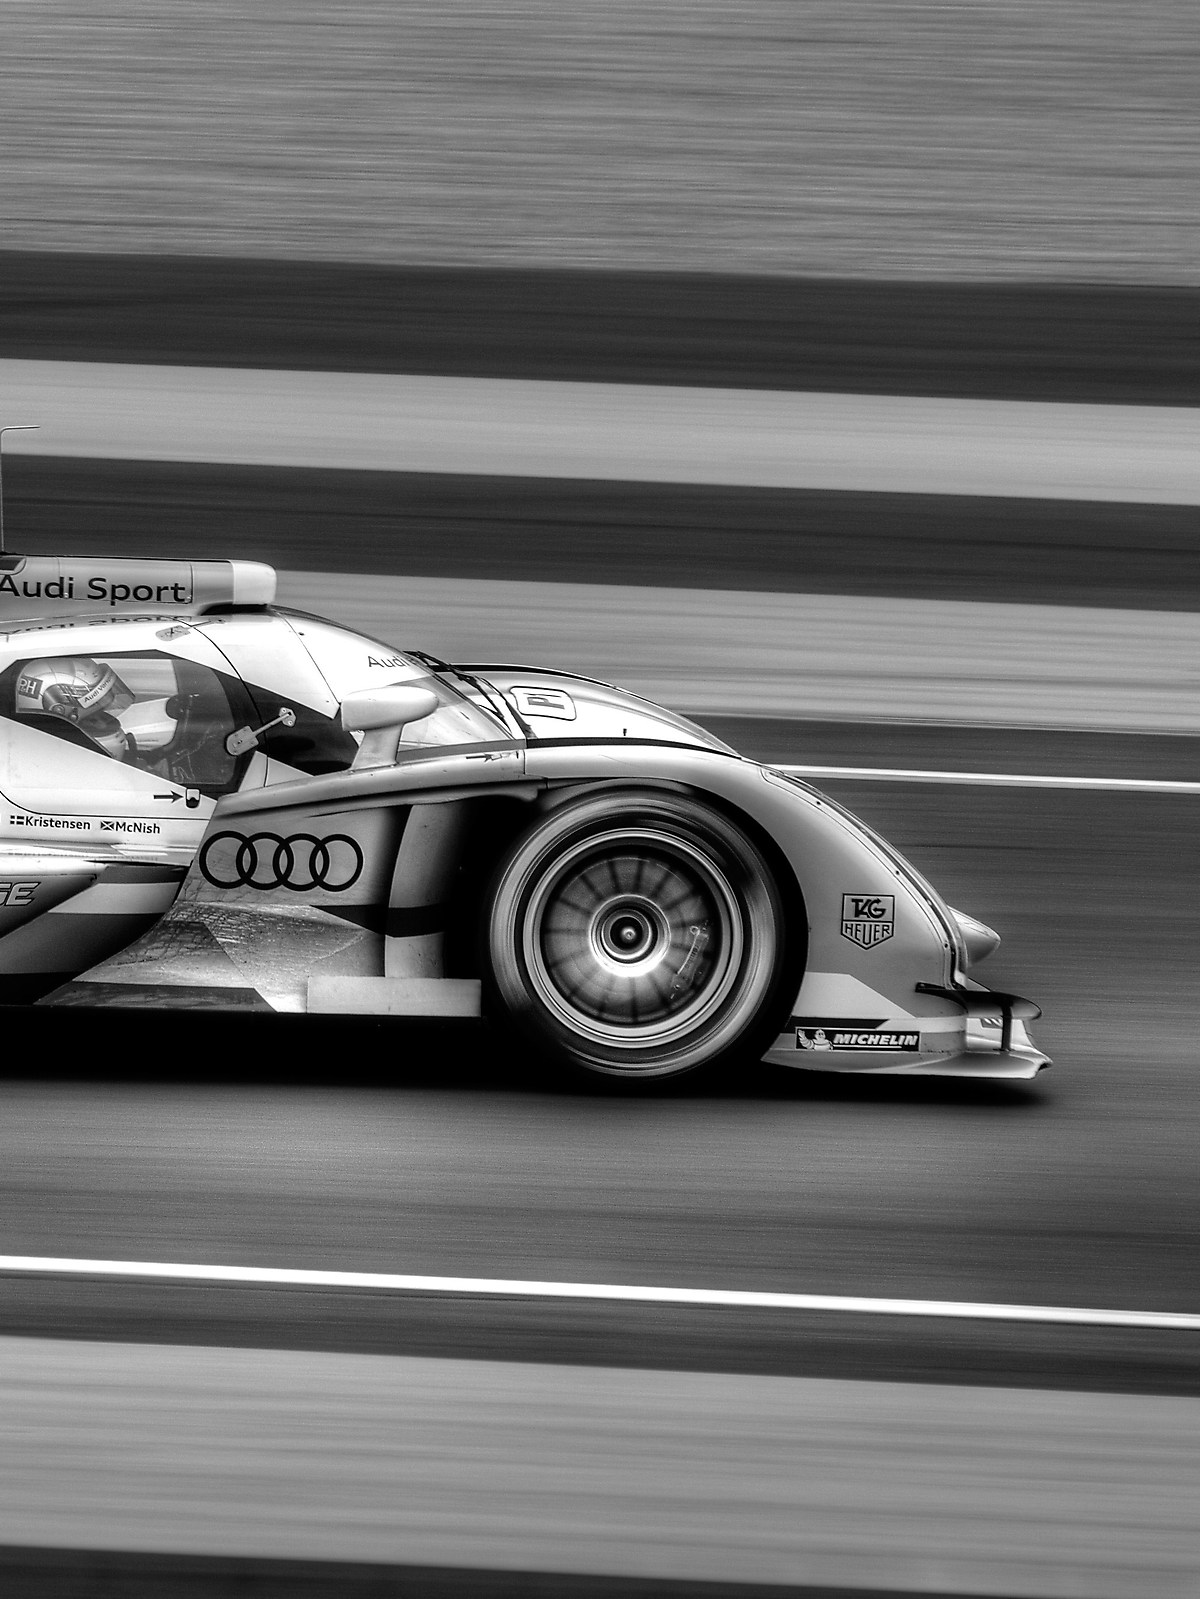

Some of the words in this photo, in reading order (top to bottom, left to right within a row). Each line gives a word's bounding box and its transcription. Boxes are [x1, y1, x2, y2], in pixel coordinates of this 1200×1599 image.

[88, 577, 186, 606] Sport
[368, 655, 411, 668] Audi
[25, 815, 91, 830] Kristensen
[115, 821, 161, 834] McNish
[851, 898, 886, 919] TAG
[844, 922, 891, 945] HEUER
[834, 1033, 919, 1046] MICHELIN
